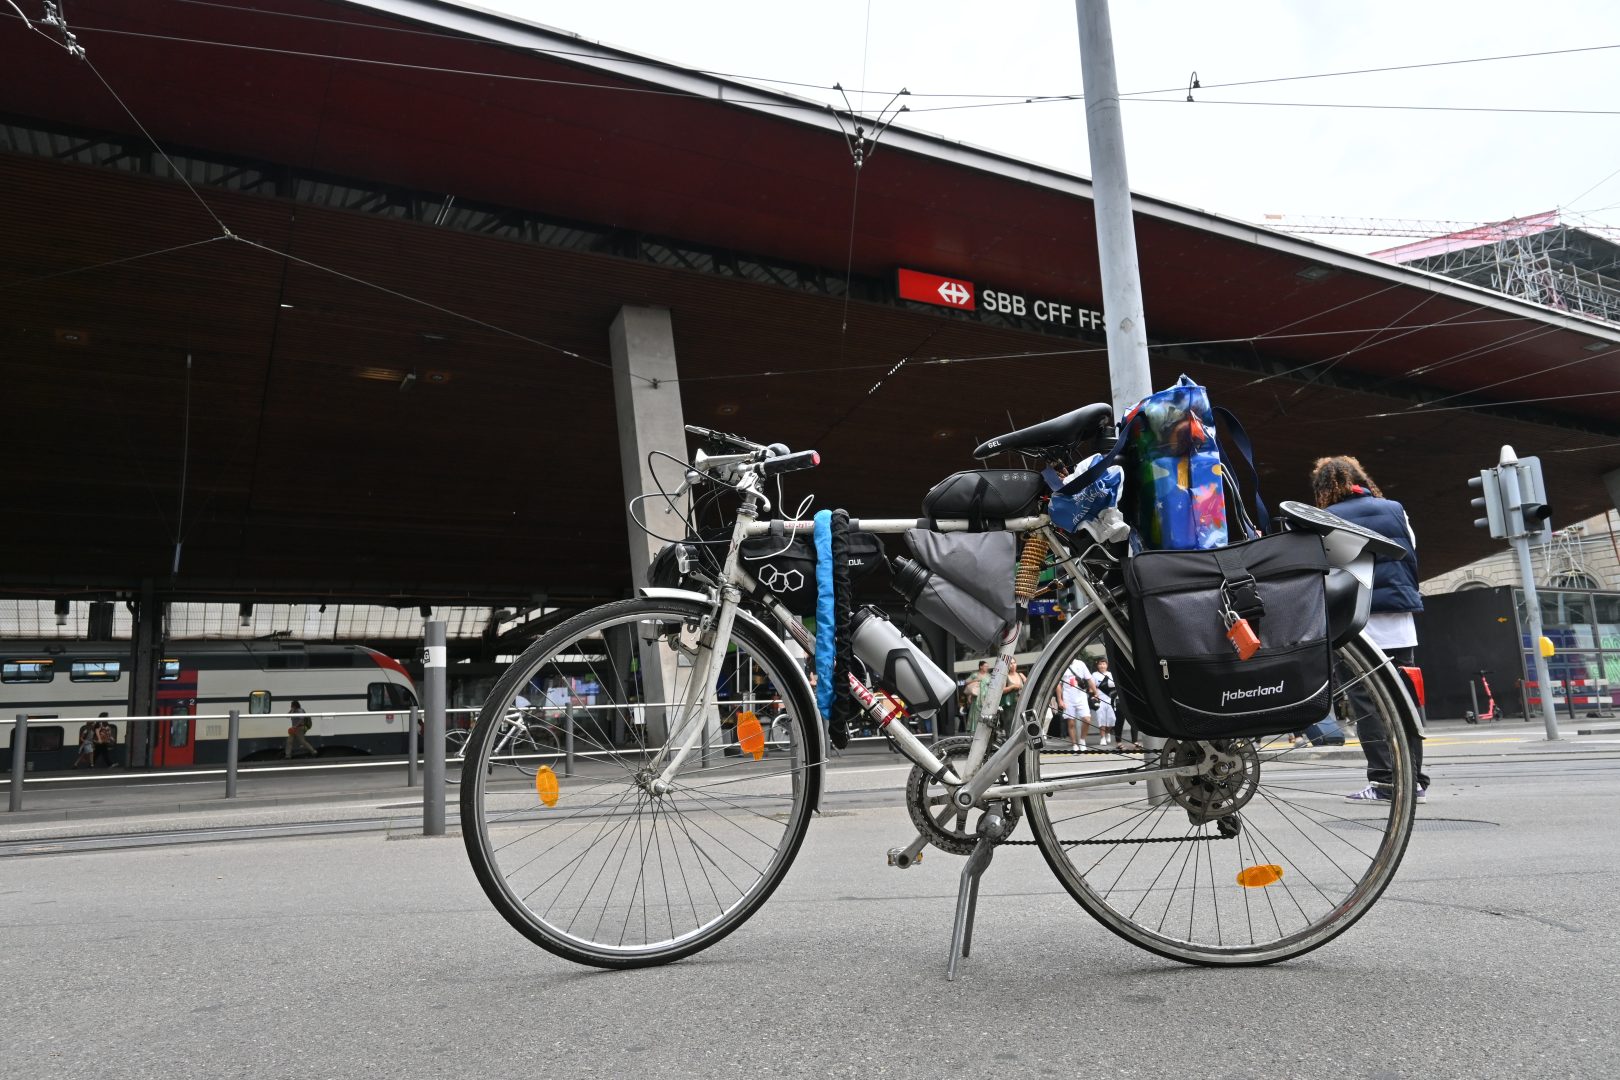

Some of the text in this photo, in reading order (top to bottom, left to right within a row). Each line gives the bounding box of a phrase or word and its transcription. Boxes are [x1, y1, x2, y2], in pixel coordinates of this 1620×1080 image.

[982, 289, 1027, 316] SBB
[1033, 300, 1072, 325] CFF
[987, 440, 1002, 449] GEL
[189, 698, 195, 706] 2
[1221, 680, 1284, 707] Haberland
